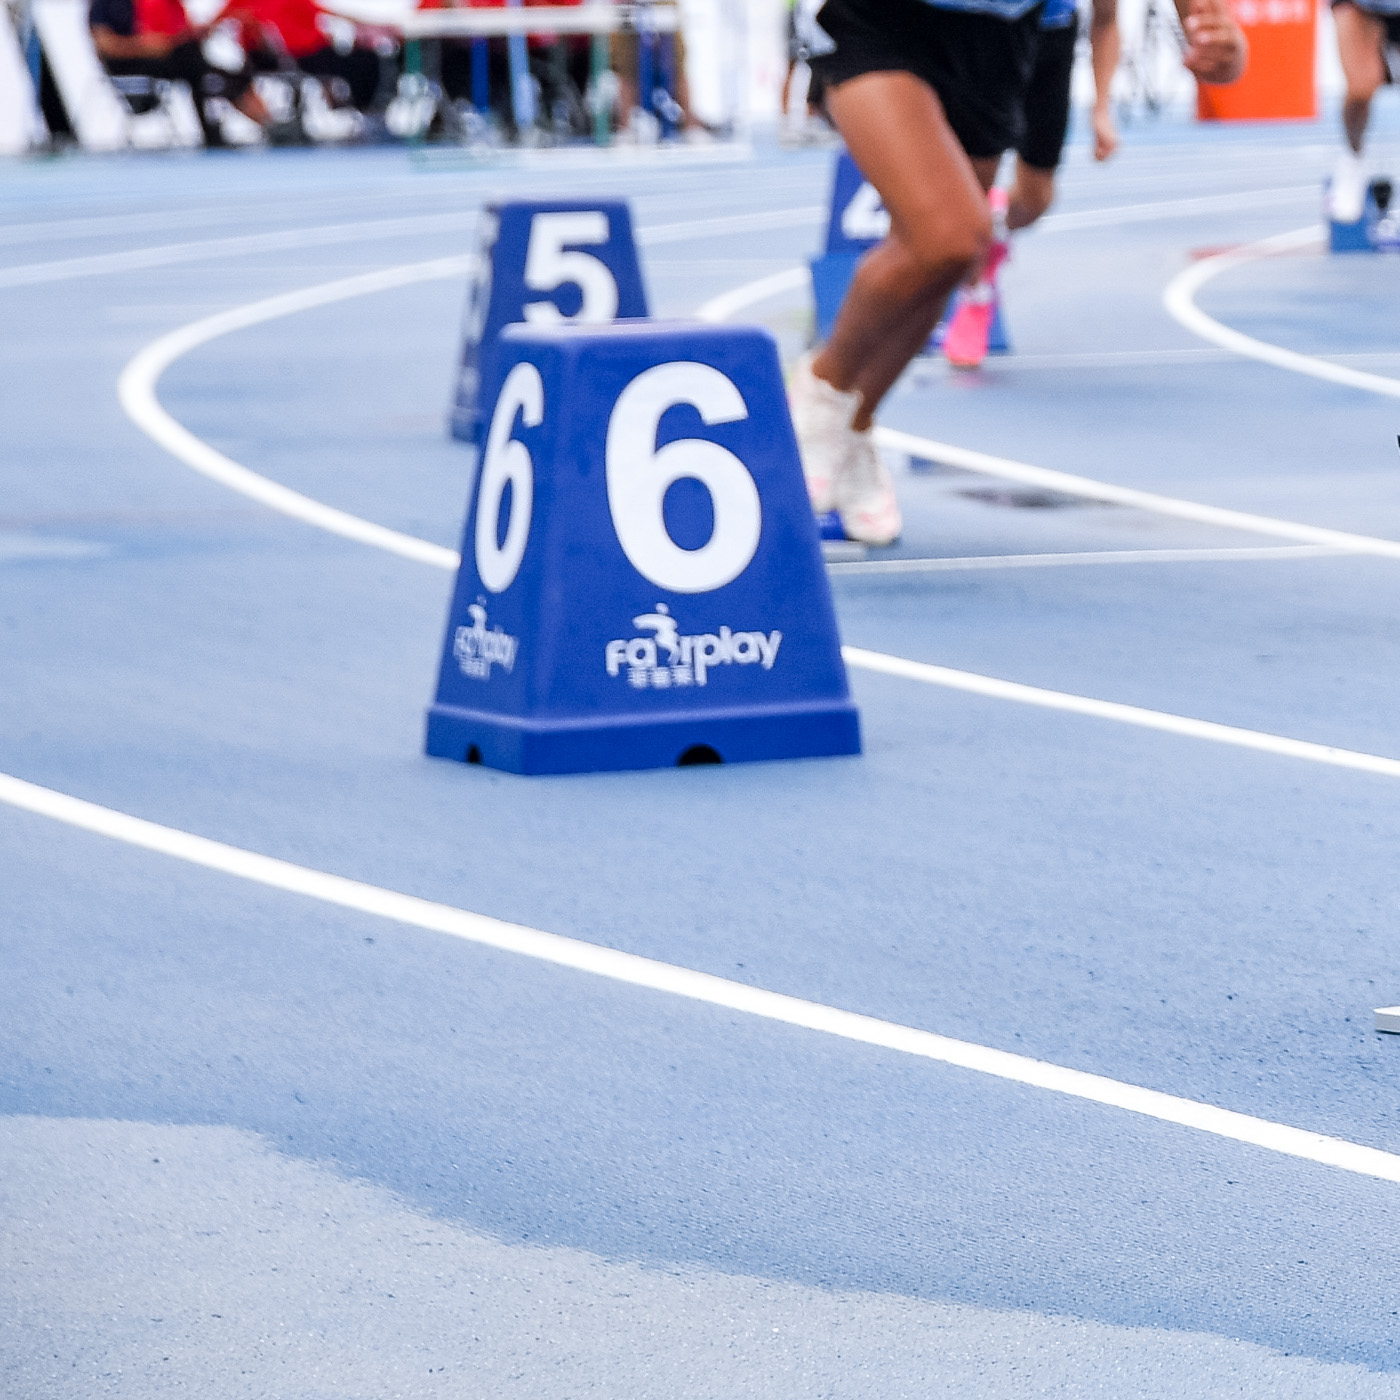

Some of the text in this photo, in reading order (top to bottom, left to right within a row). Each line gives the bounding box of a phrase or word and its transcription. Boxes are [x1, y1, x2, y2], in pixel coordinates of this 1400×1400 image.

[522, 211, 620, 327] 5
[475, 361, 545, 594] 6
[605, 361, 763, 594] 6
